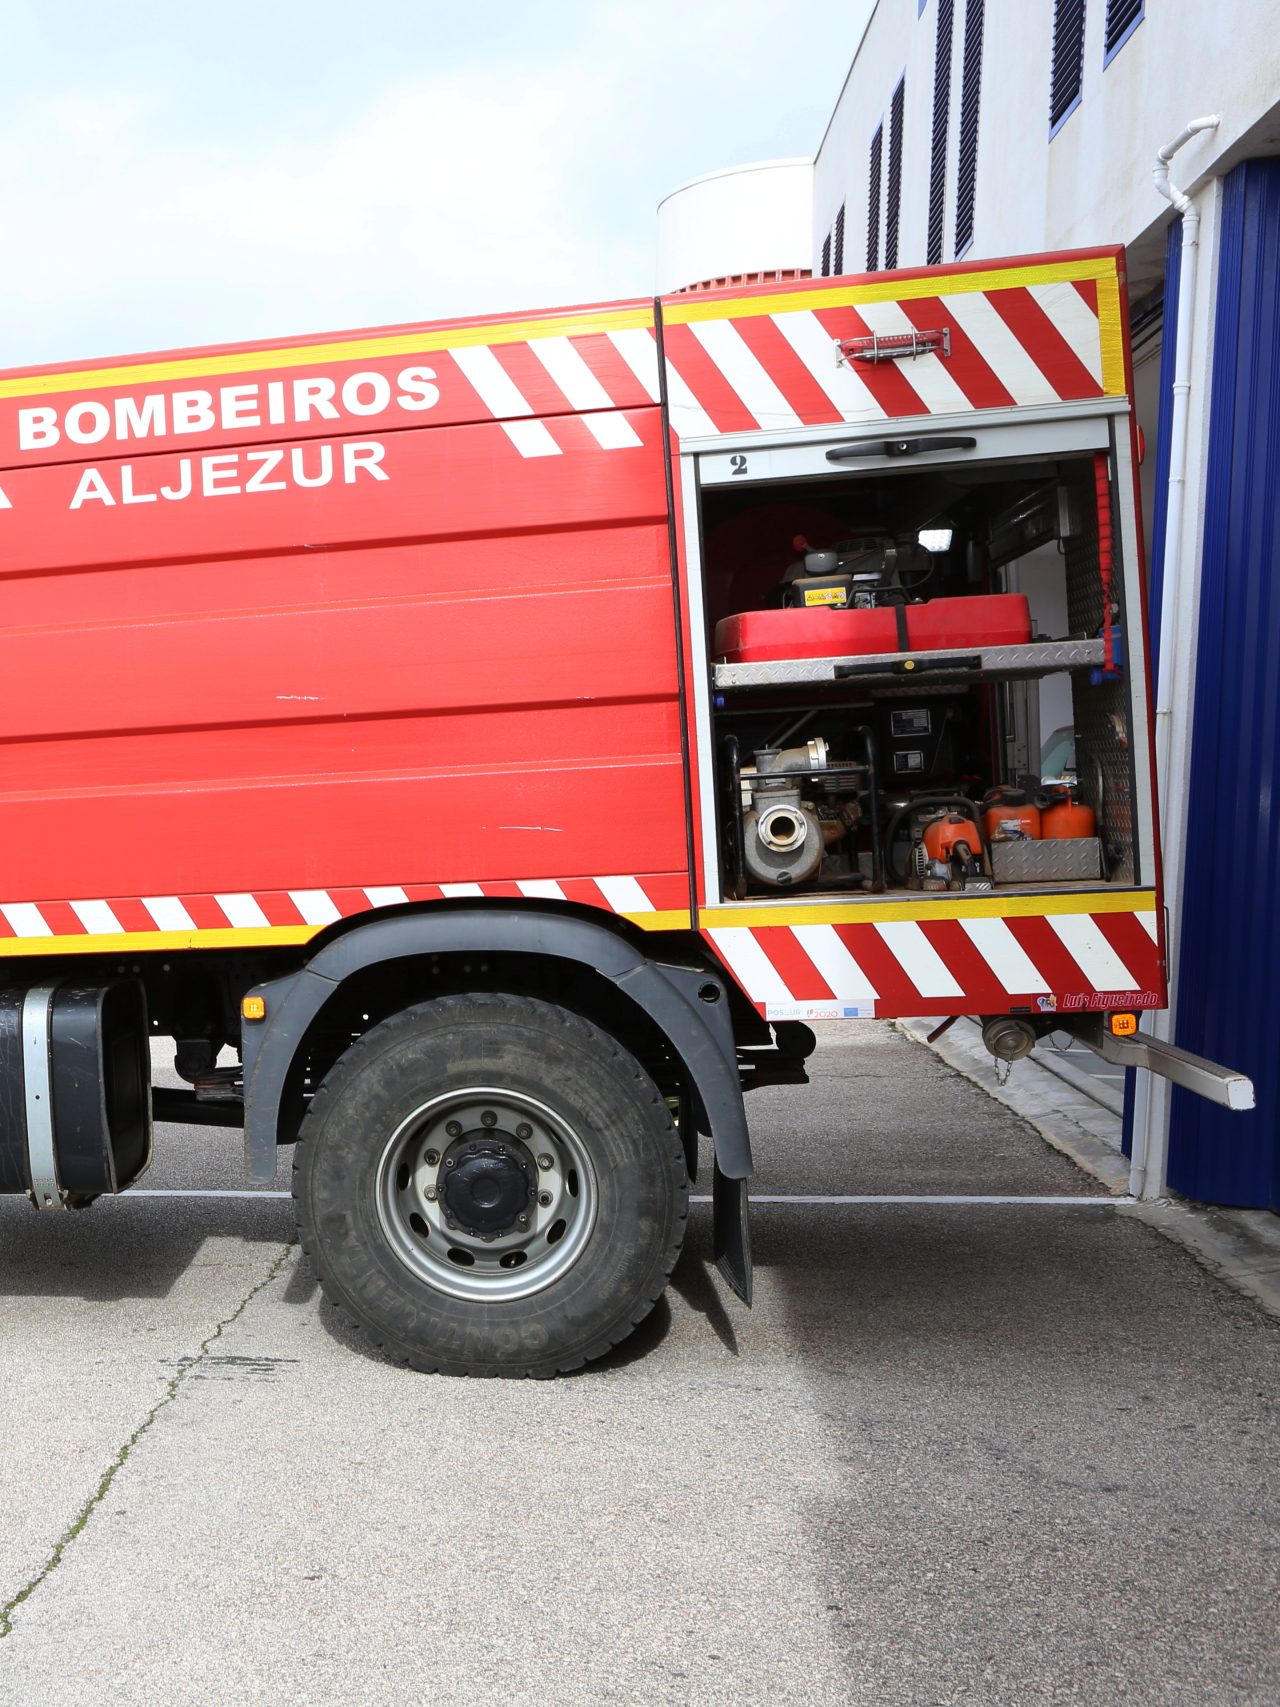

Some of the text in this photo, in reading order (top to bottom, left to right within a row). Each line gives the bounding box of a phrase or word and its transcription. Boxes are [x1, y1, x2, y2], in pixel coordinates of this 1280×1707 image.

[18, 366, 440, 451] BOMBEIROS
[69, 441, 390, 509] ALJEZUR
[730, 455, 748, 475] 2
[1091, 991, 1158, 1009] Figueiredo
